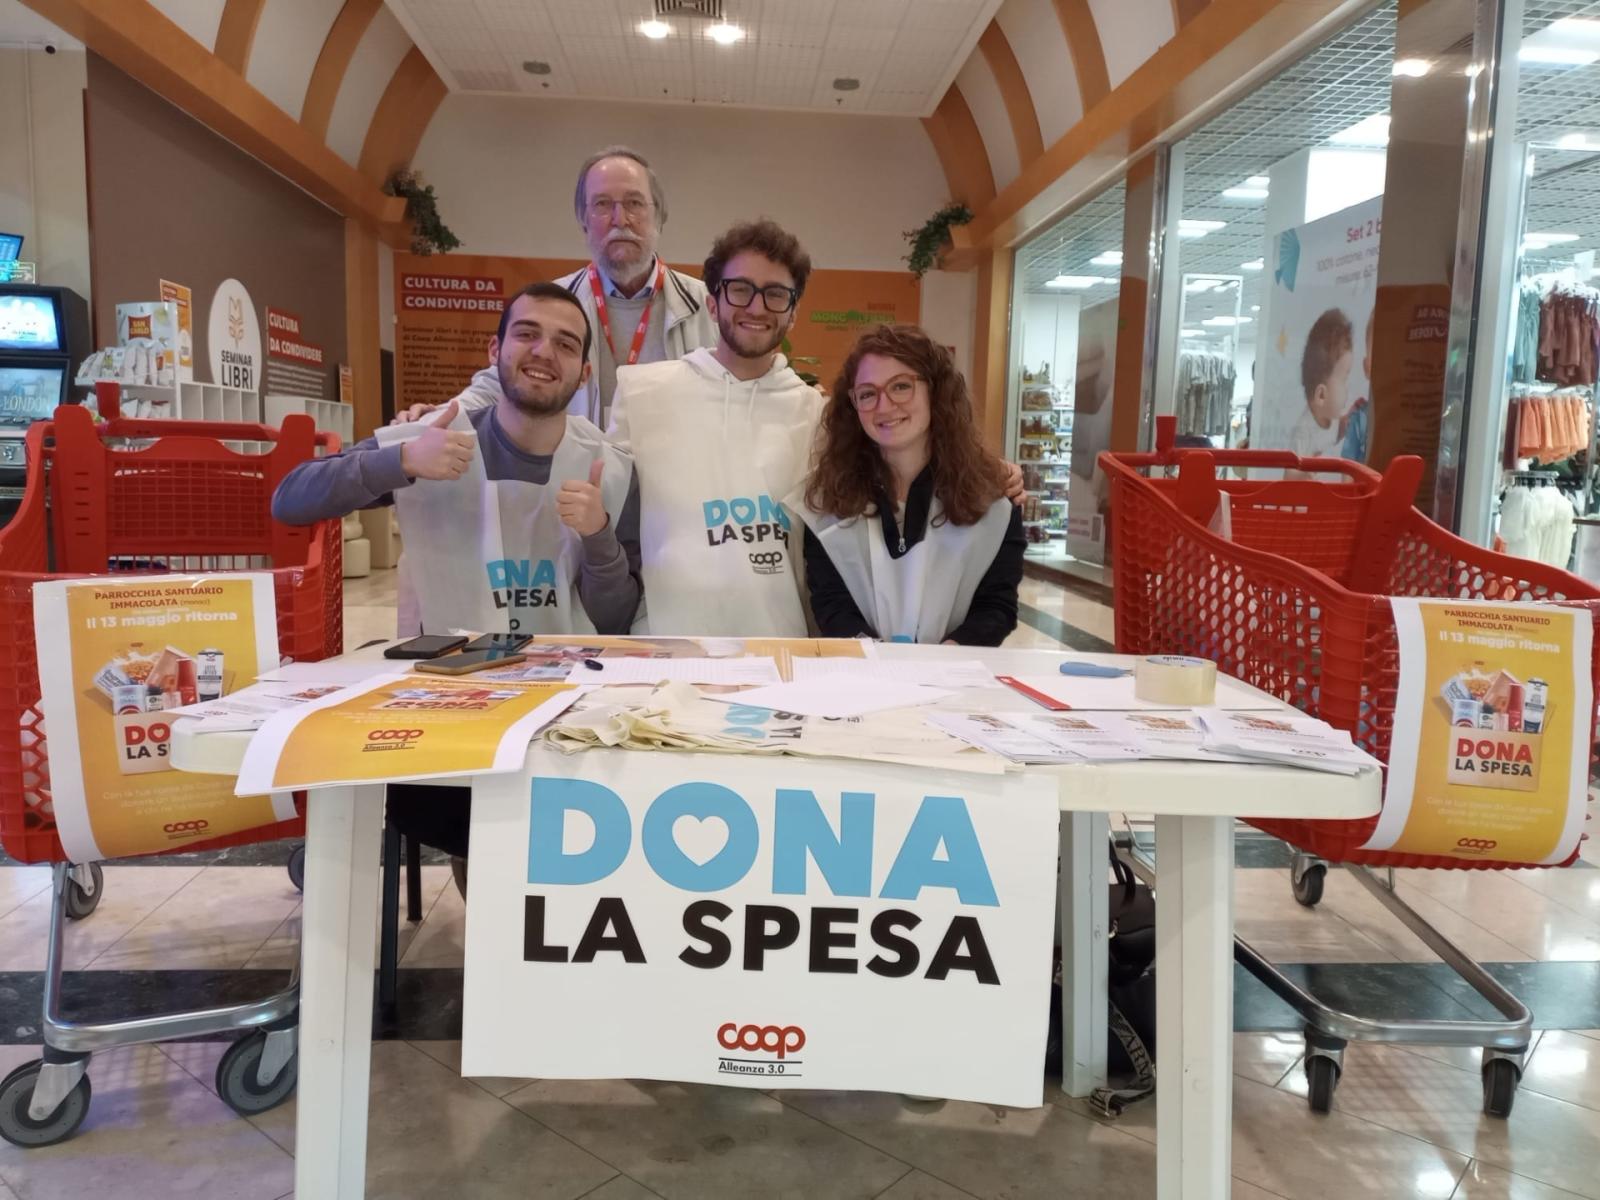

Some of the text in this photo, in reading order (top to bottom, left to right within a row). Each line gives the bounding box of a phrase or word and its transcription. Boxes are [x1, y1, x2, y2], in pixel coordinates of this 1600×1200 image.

[1347, 225, 1363, 243] Set
[404, 277, 496, 292] CULTURA DA
[405, 296, 504, 311] CONDIVIDERE
[269, 312, 299, 334] CULTURA
[270, 337, 280, 352] DA
[221, 350, 252, 366] SEMINAR
[222, 365, 253, 390] LIBRI
[707, 523, 788, 550] LA SPE
[749, 551, 782, 566] coop
[95, 587, 223, 600] PARROCCHIA SANTUARIO
[110, 598, 178, 609] IMMACOLATA
[86, 617, 96, 629] Il
[101, 616, 117, 628] 13
[122, 611, 181, 627] maggio
[186, 609, 238, 622] ritorna
[1444, 609, 1551, 626] PARROCCHIA SANTUARIO
[1458, 619, 1514, 631] IMMACOLATA
[1450, 631, 1464, 643] 13
[1468, 634, 1515, 649] maggio
[1519, 640, 1561, 653] ritorna
[124, 723, 170, 746] DO
[367, 729, 424, 742] coop
[126, 743, 151, 760] LA
[1456, 738, 1533, 763] DONA
[1455, 758, 1533, 777] LA SPESA
[163, 819, 208, 834] coop
[527, 777, 1000, 906] DONA
[1457, 837, 1497, 850] coop
[523, 895, 1001, 985] LA SPESA
[717, 1022, 806, 1060] coop
[719, 1061, 785, 1074] Alleanza 3.0
